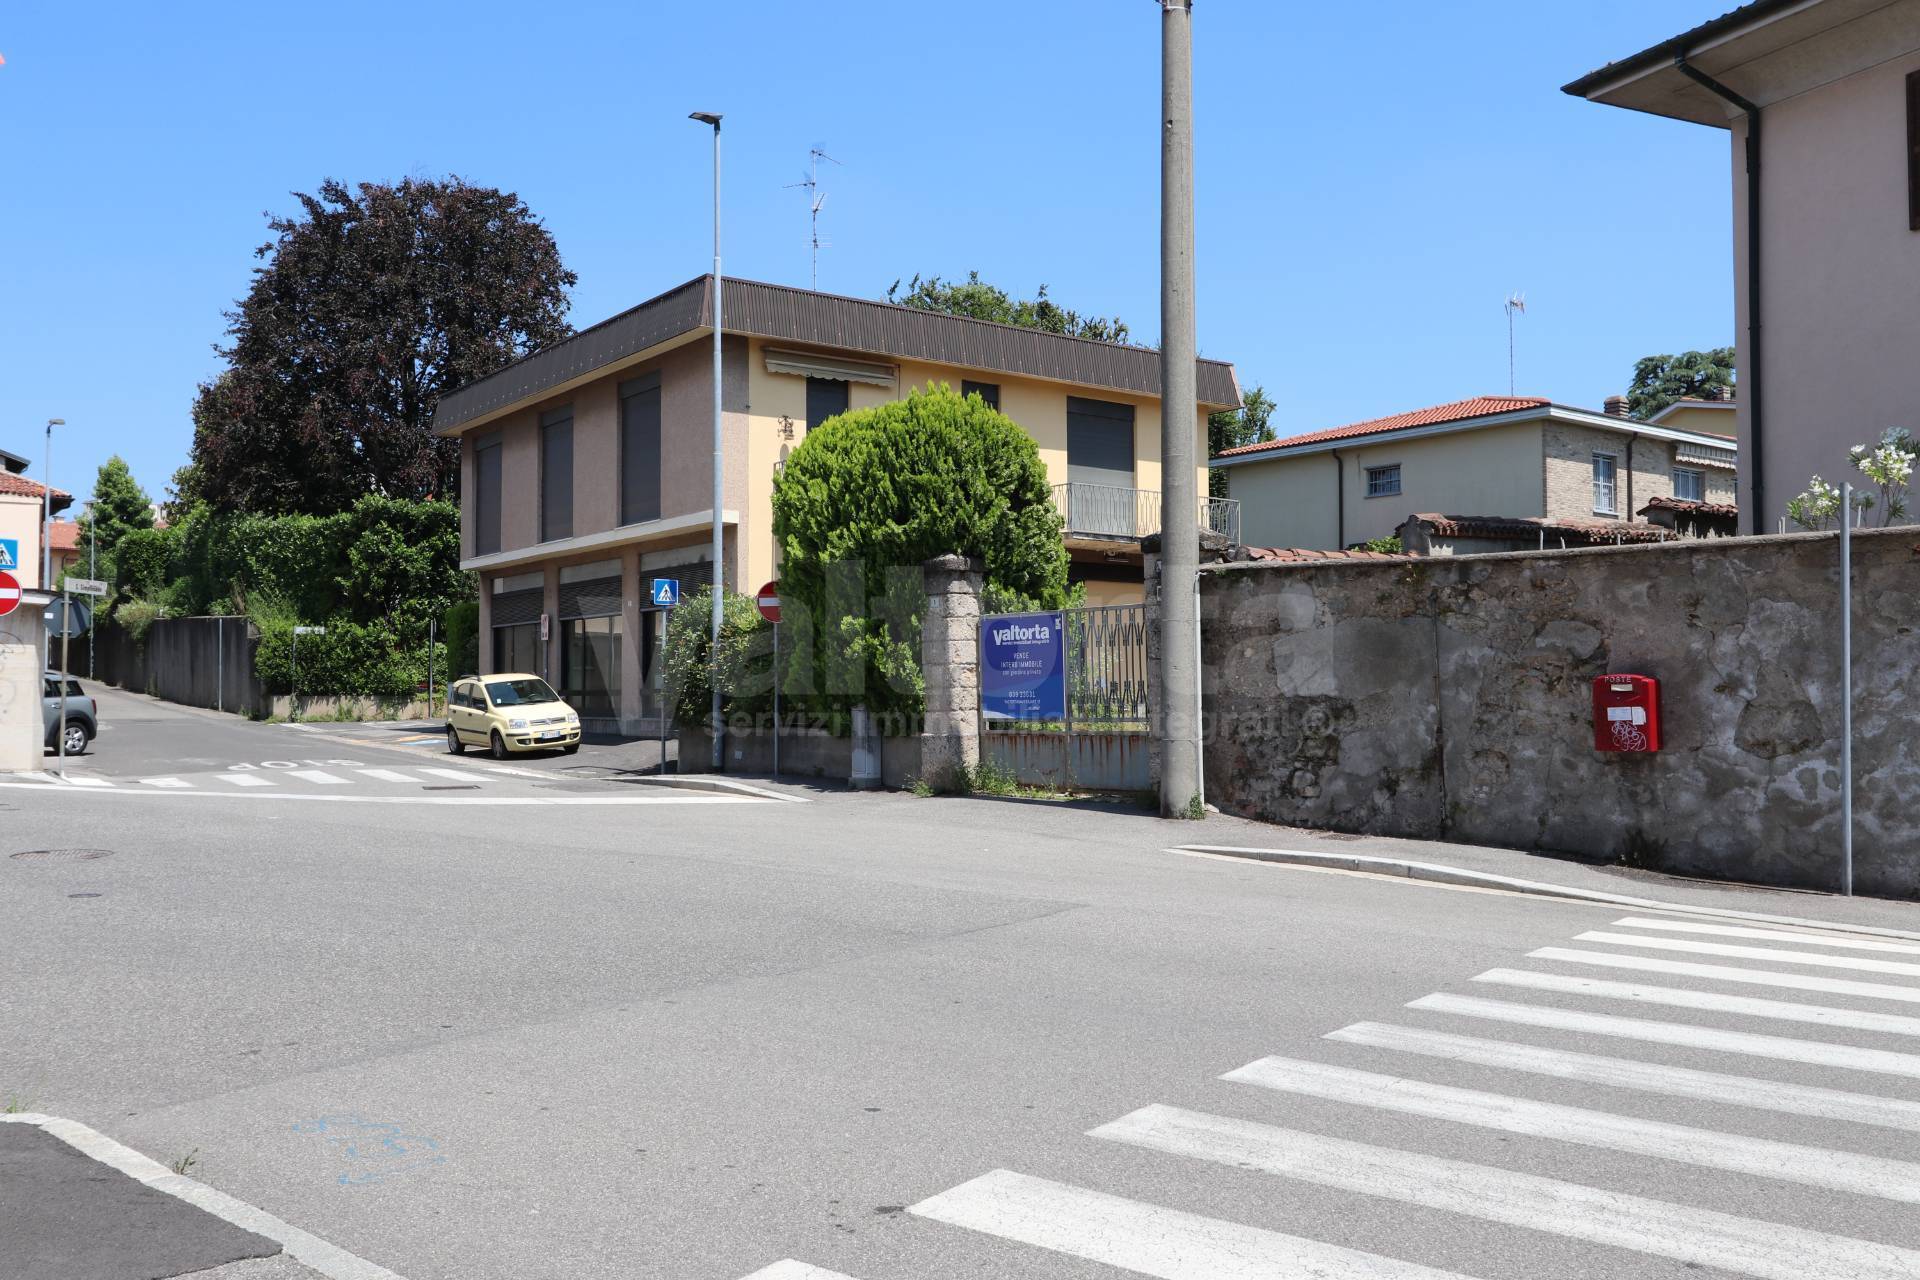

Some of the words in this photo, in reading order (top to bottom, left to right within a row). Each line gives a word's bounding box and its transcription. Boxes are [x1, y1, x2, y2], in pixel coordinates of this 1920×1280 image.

[993, 624, 1050, 646] valtorta
[1013, 652, 1030, 660] VENDE
[227, 759, 366, 771] STOP
